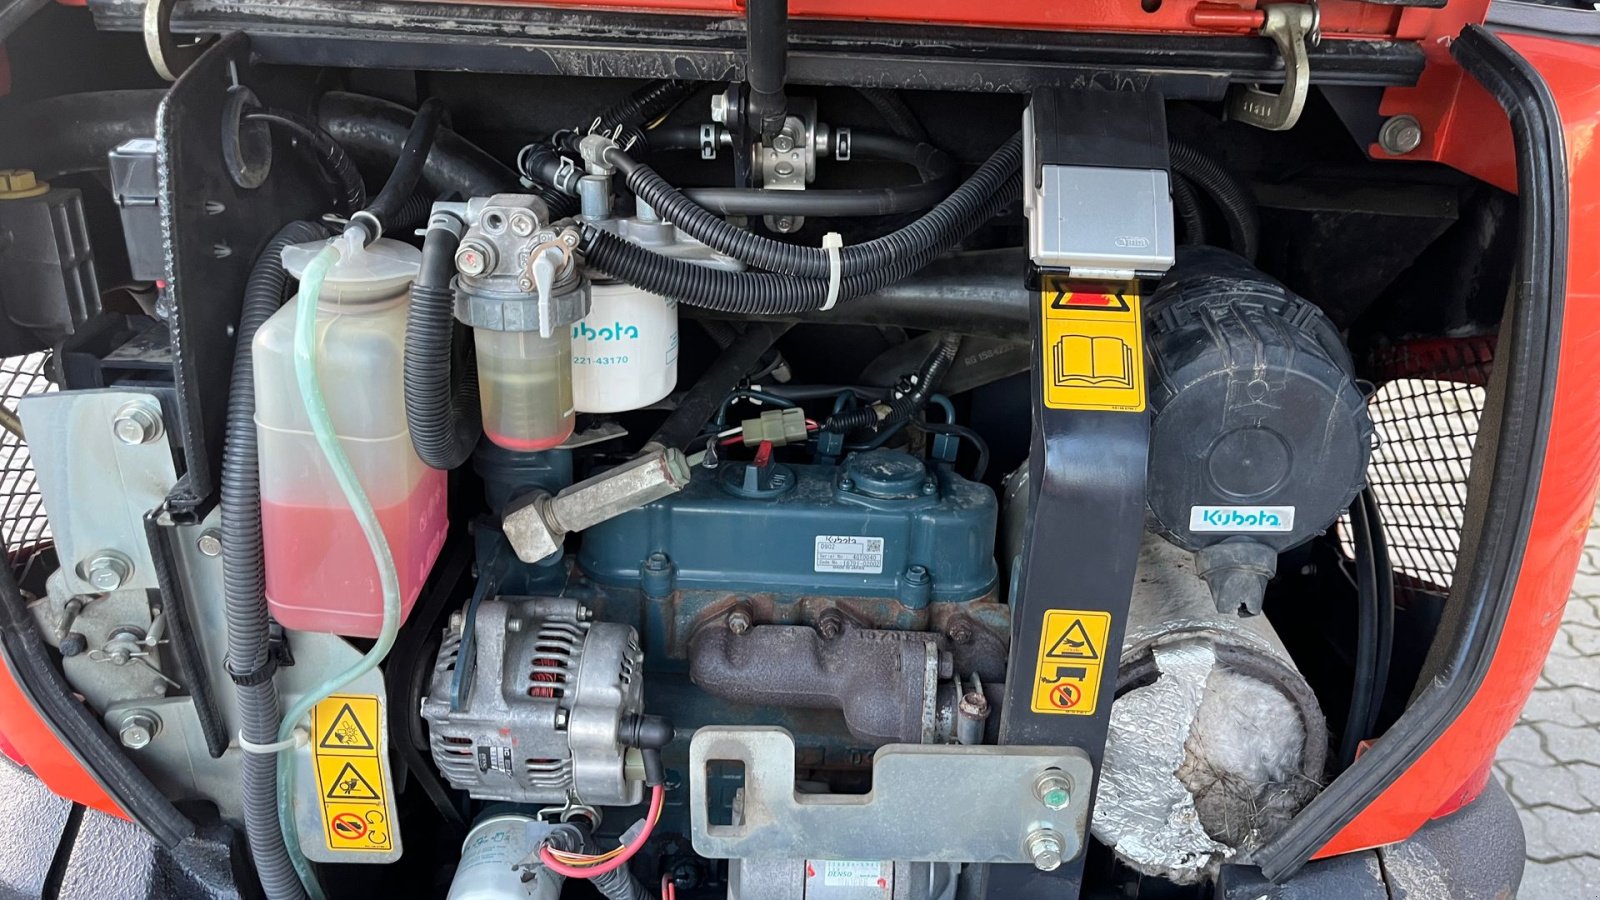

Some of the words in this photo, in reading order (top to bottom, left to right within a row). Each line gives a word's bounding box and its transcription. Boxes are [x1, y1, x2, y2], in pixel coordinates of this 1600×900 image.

[1203, 510, 1281, 526] Kubota
[826, 536, 857, 544] Kubota
[828, 870, 853, 878] DENSO
